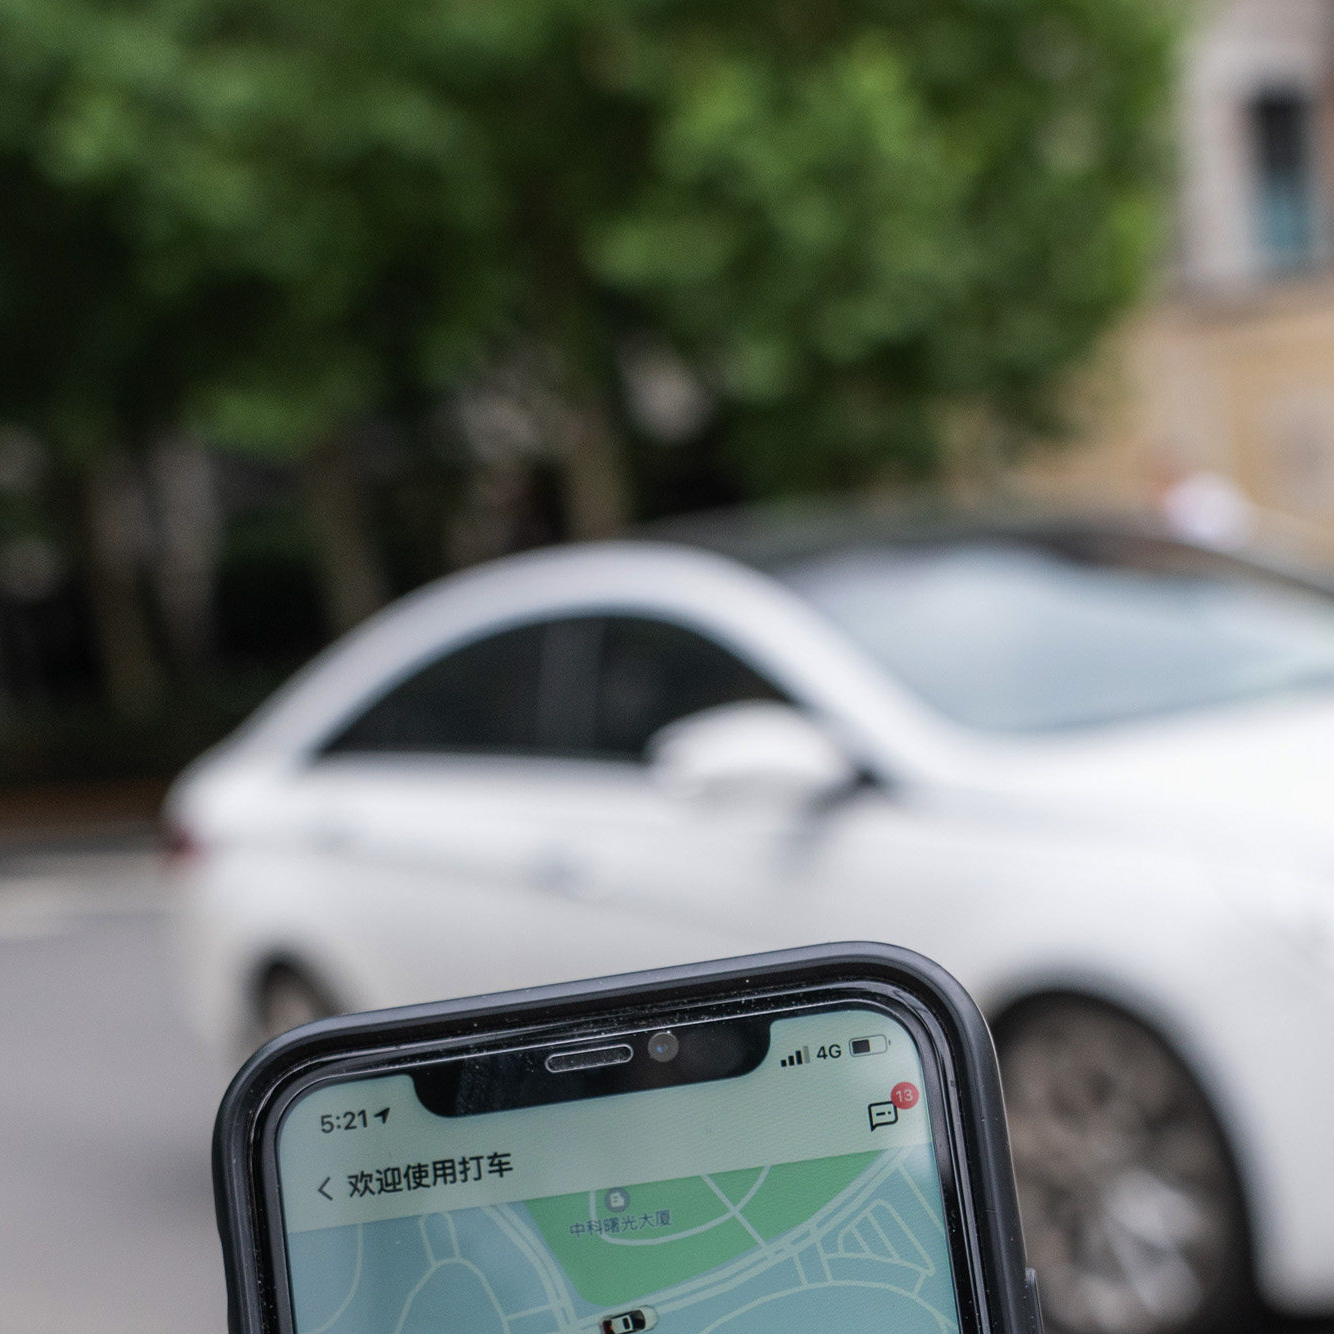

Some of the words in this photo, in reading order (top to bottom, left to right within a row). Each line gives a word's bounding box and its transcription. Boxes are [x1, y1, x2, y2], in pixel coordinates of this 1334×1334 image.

[816, 1043, 842, 1060] 4G
[895, 1089, 914, 1103] 13
[320, 1109, 368, 1133] 5:21
[347, 1152, 514, 1198] 欢迎使用打车
[569, 1209, 672, 1237] 中科曙光大厦
